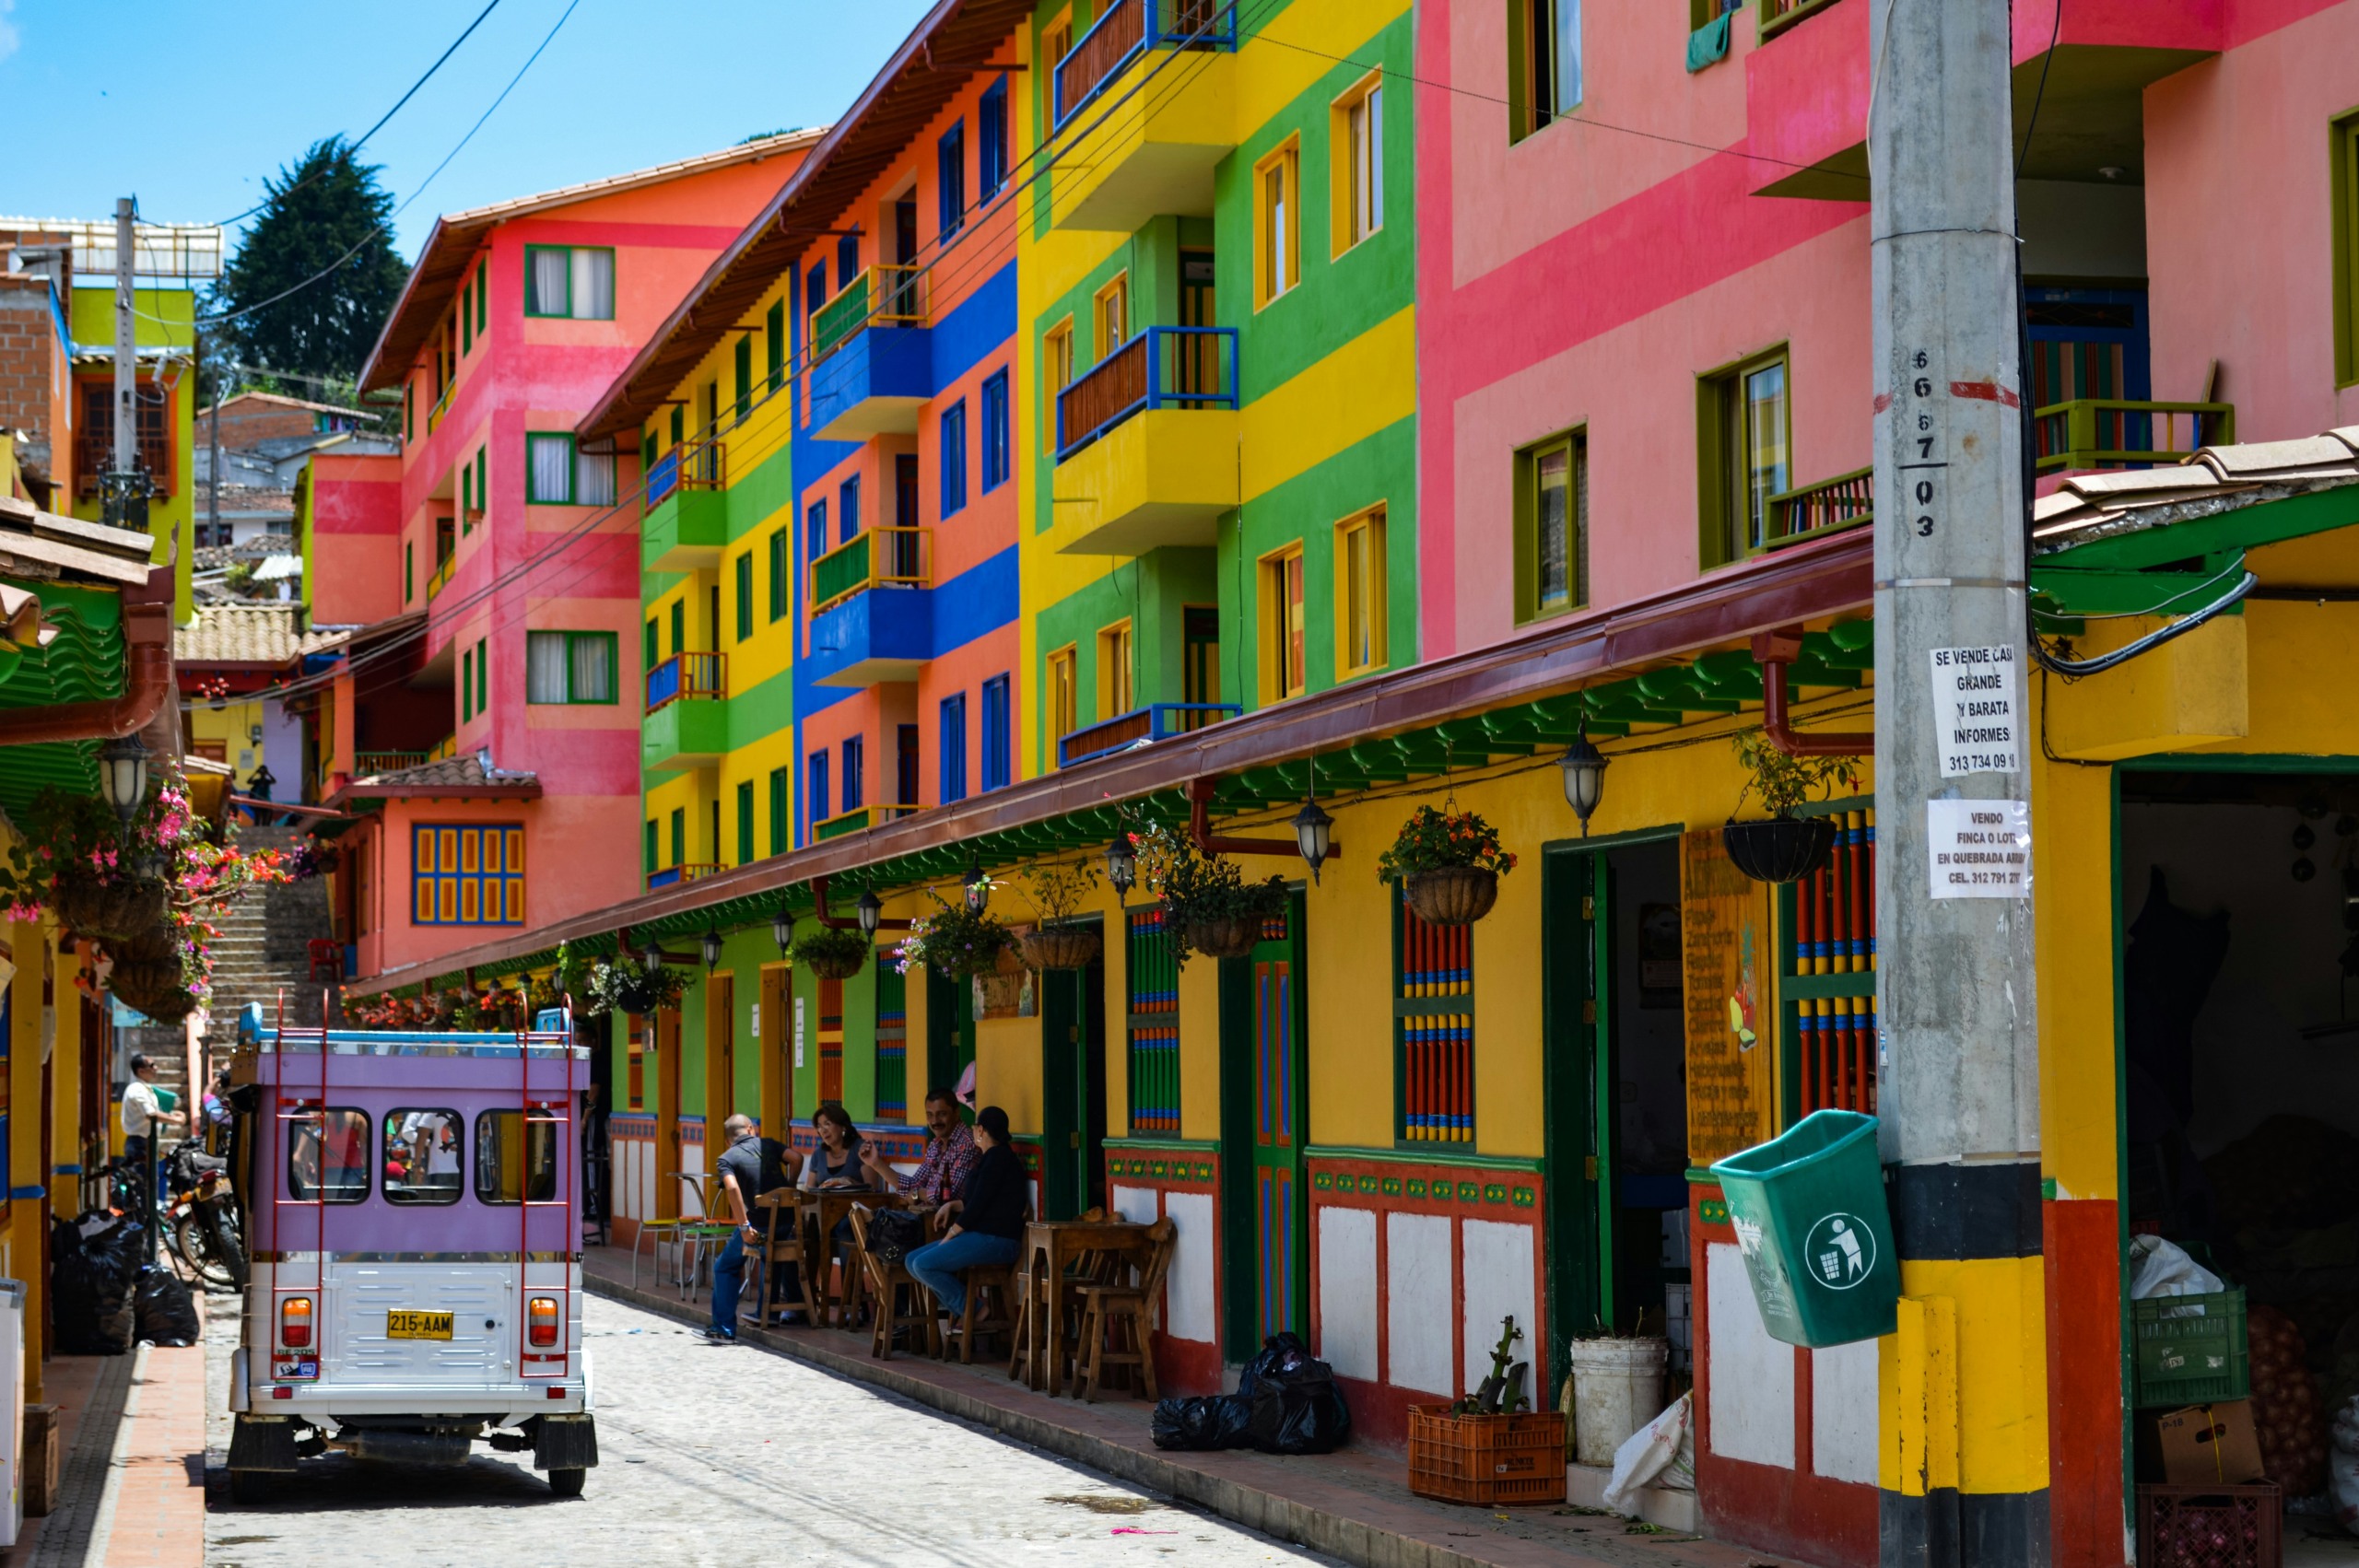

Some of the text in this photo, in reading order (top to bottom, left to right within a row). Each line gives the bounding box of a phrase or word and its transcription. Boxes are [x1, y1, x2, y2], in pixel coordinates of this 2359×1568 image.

[1935, 647, 2013, 666] SE VENDE CASA
[1957, 674, 2001, 691] GRANDE
[1956, 700, 2009, 717] Y BARATA
[1949, 755, 1969, 771] 313
[1972, 754, 1991, 769] 734
[1993, 754, 2006, 768] 09
[1971, 813, 2003, 825] VENDO
[1957, 832, 1986, 844] FINCA
[1988, 833, 1995, 844] O
[1938, 853, 1951, 865] EN
[1953, 853, 2004, 864] QUEBRADA
[1949, 872, 1969, 884] CEL.
[1972, 872, 1989, 884] 312
[1990, 872, 2007, 884] 791
